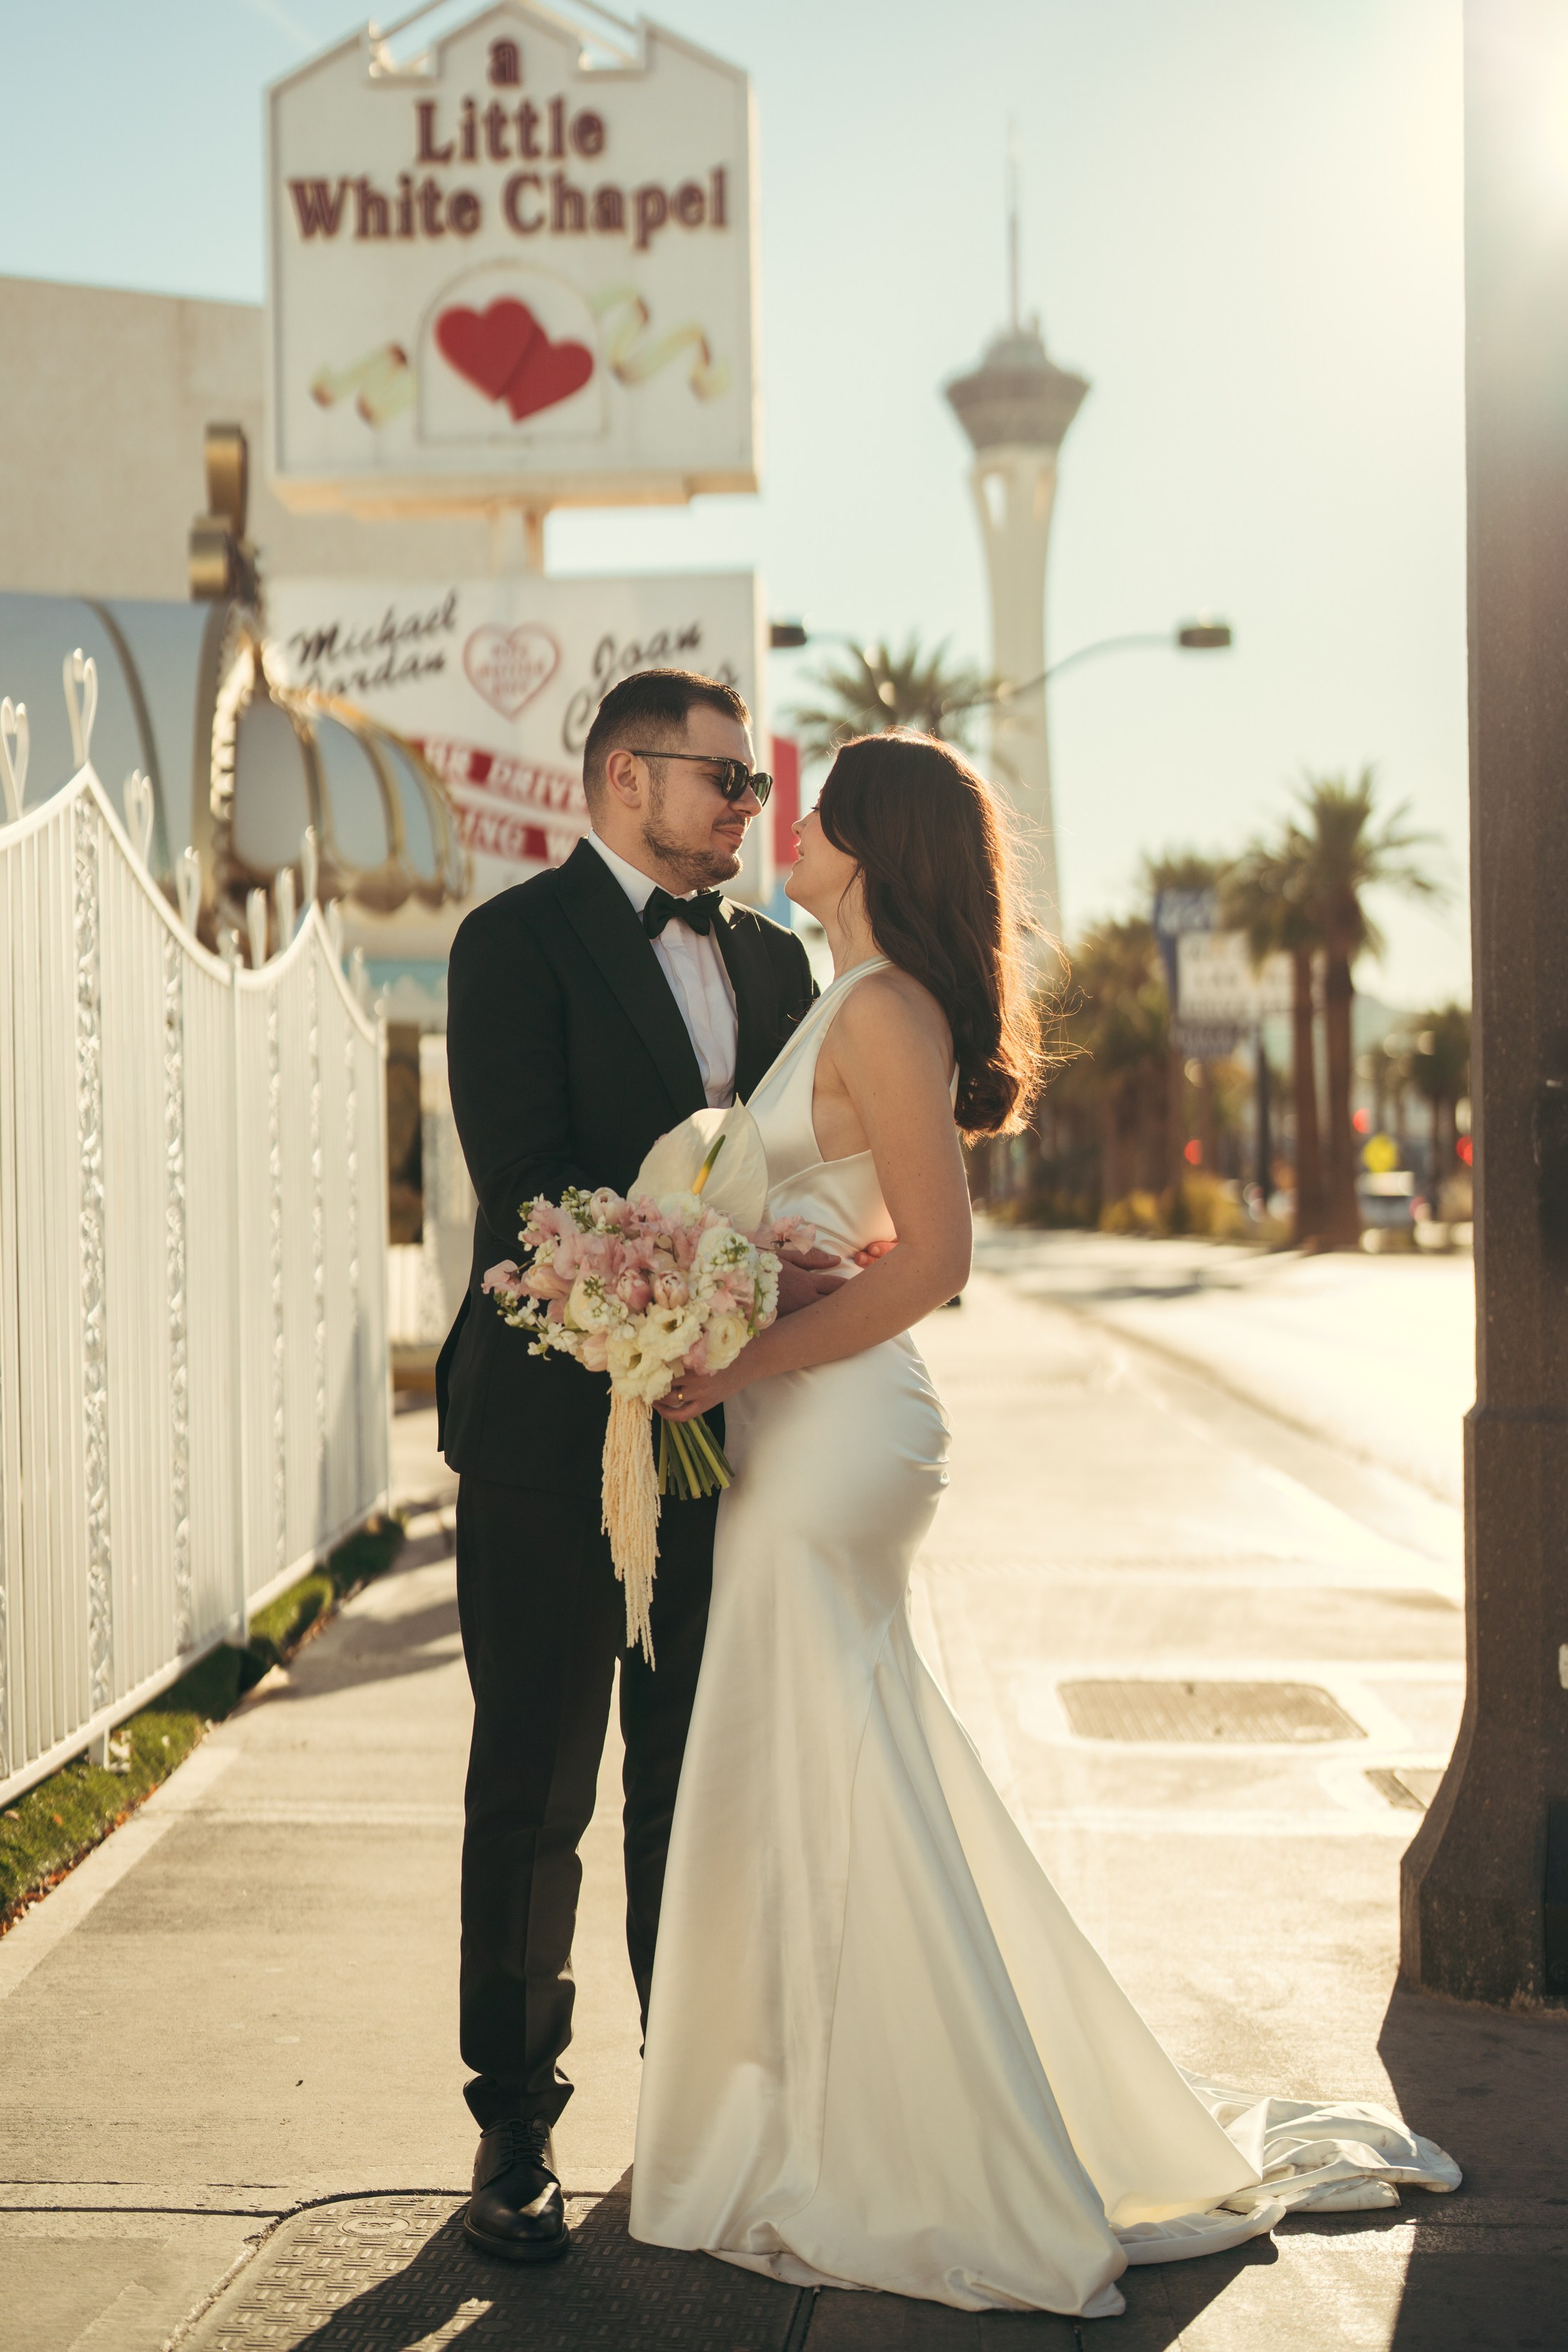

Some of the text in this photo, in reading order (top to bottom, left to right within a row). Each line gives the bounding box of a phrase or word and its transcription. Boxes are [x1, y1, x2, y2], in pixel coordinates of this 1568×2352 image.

[488, 38, 522, 87] a
[416, 96, 607, 165] Little
[288, 166, 728, 252] White Chapel
[287, 587, 457, 666] Michael
[592, 621, 702, 697] Joan
